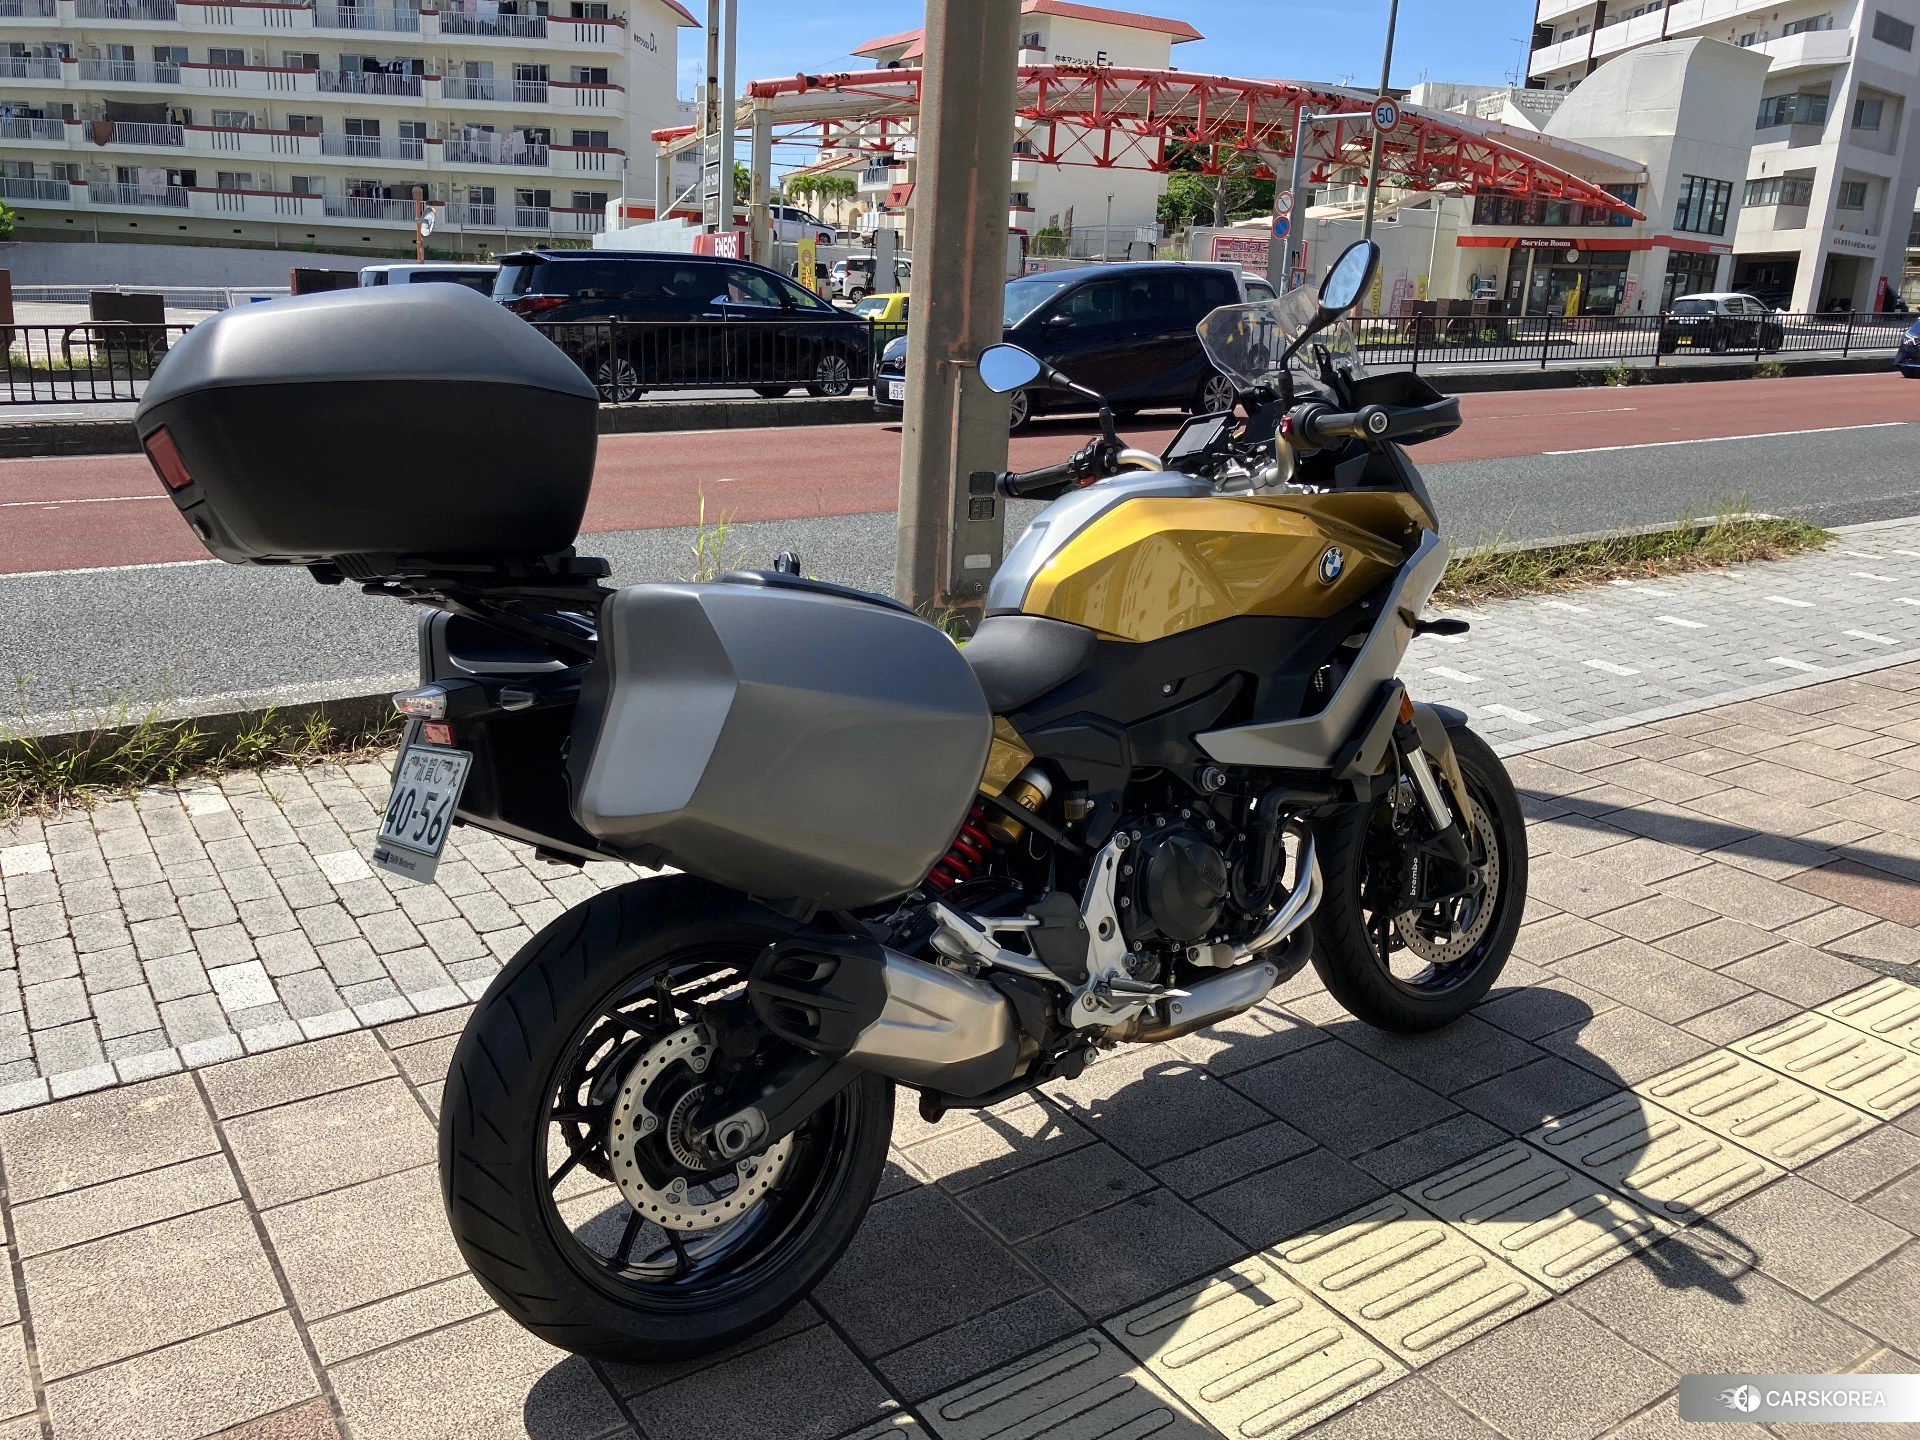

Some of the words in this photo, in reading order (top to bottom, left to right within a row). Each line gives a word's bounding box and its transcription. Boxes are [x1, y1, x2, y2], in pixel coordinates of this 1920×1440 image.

[1377, 107, 1394, 123] 50
[714, 235, 737, 258] ENEOS
[1520, 239, 1549, 247] Service
[1550, 239, 1571, 247] Room
[386, 786, 451, 846] 40-56
[1410, 857, 1418, 896] brembo
